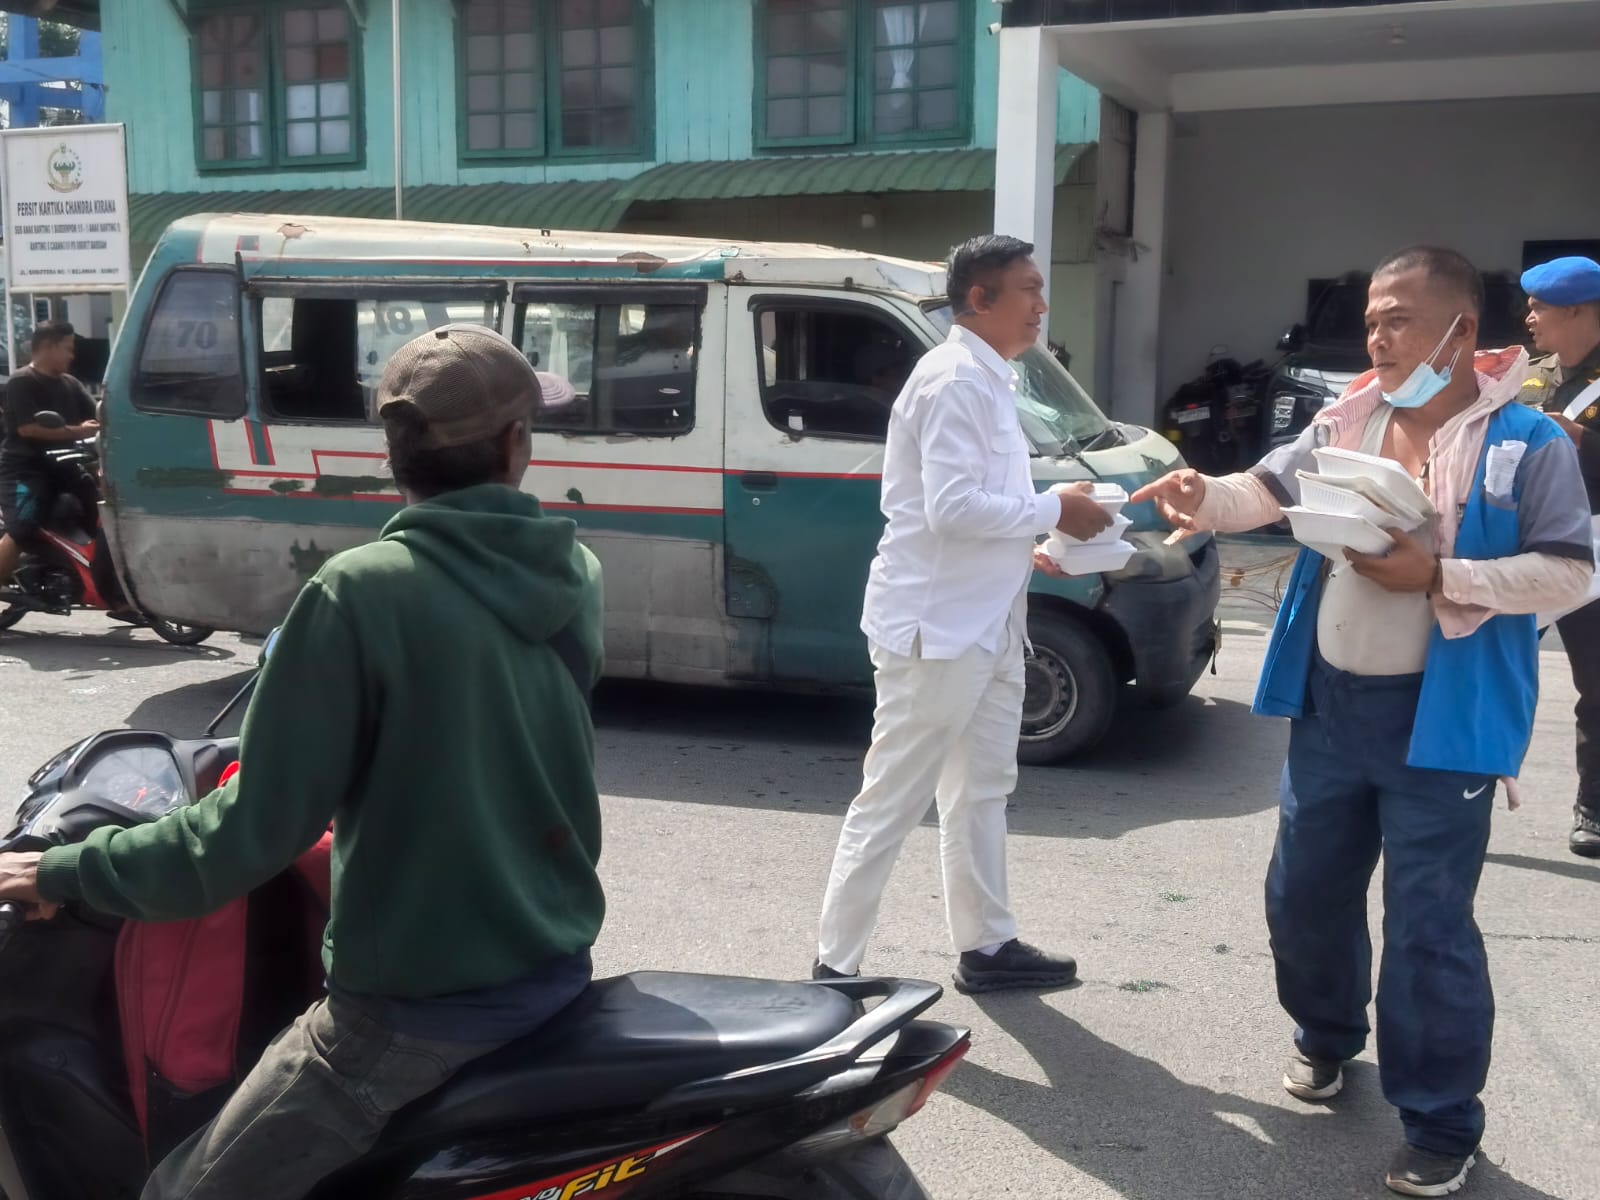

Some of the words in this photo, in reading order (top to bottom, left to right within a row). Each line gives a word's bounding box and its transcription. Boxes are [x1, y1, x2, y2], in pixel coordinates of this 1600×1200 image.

[17, 202, 37, 216] PERSIT
[38, 201, 64, 215] KARTIKA
[65, 200, 93, 215] CHANDRA
[94, 199, 117, 214] KIRANA
[177, 320, 218, 350] 70
